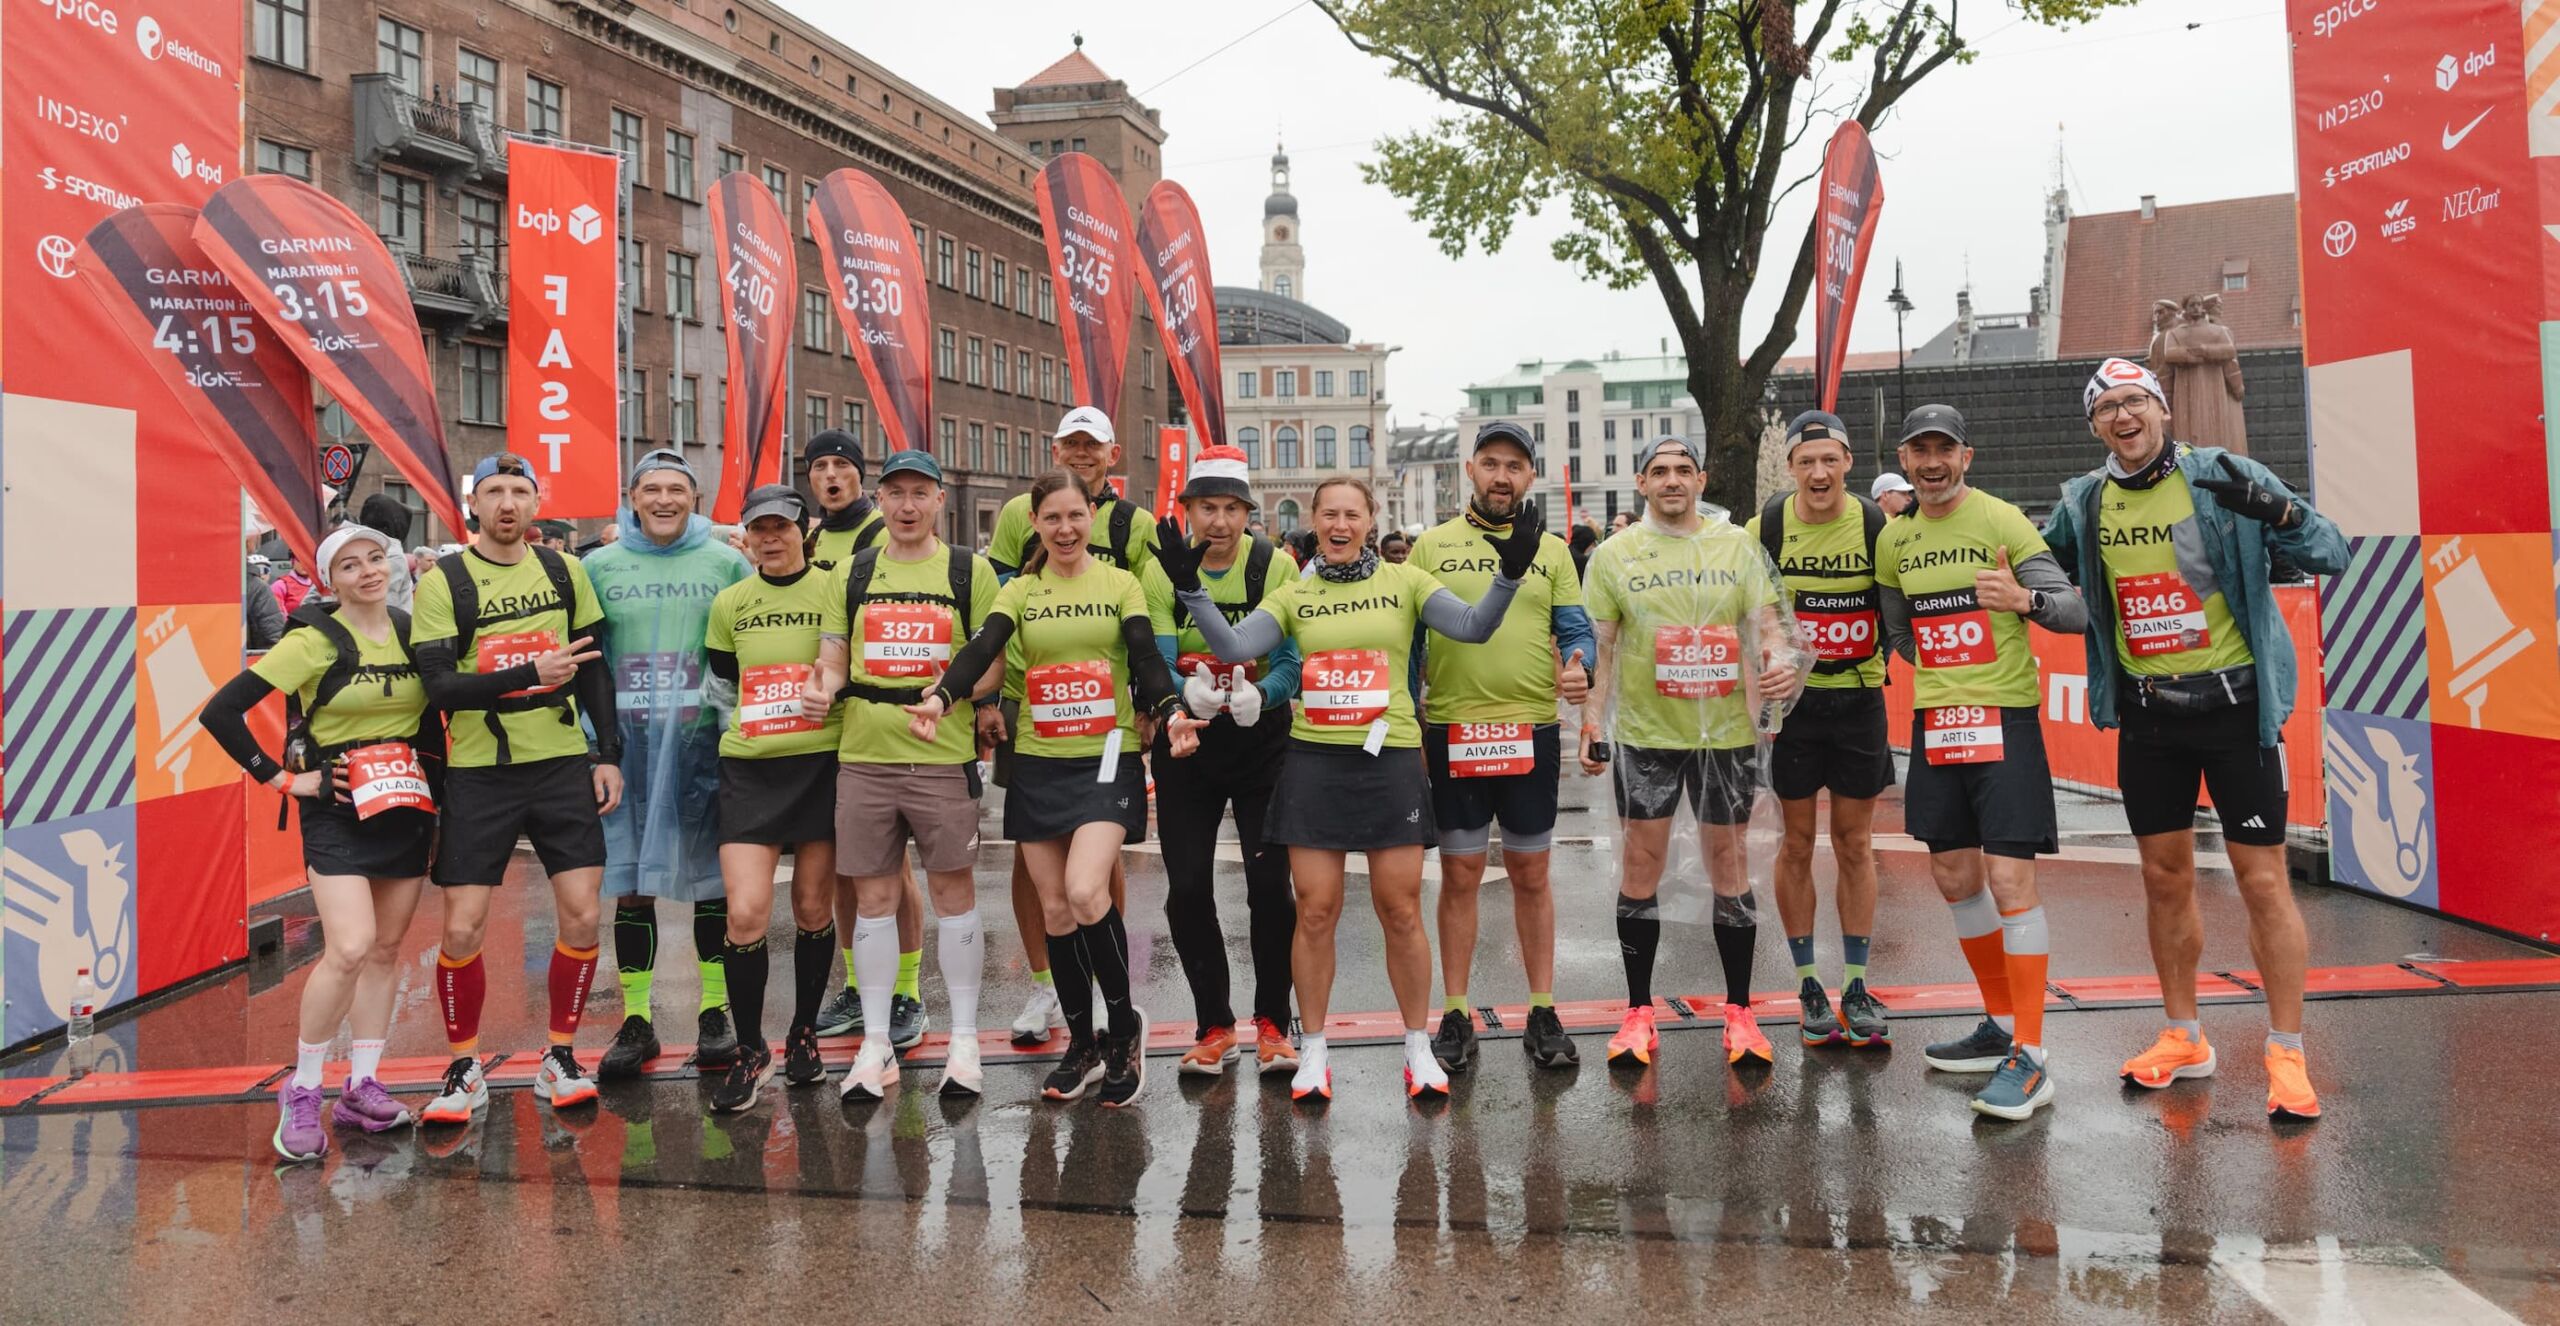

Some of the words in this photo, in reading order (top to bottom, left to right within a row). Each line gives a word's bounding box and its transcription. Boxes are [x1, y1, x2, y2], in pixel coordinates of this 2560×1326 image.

[40, 0, 118, 34] pice
[167, 40, 222, 77] elektrum
[2464, 43, 2495, 76] dpd
[38, 96, 120, 143] INDEXO
[2319, 90, 2383, 131] INDEXO
[196, 159, 222, 184] dpd
[2340, 142, 2411, 181] SPORTLAND
[1828, 182, 1860, 208] GARMIN
[1067, 206, 1118, 241] GARMIN
[2381, 216, 2416, 238] WESS
[260, 237, 352, 254] GARMIN
[737, 222, 782, 267] GARMIN
[844, 229, 900, 254] GARMIN
[1064, 228, 1107, 258] MARATHON
[1158, 229, 1191, 268] GARMIN
[1827, 227, 1854, 275] 3:00
[267, 265, 342, 279] MARATHON
[347, 264, 359, 276] in
[733, 242, 771, 280] MARATHON
[843, 255, 892, 275] MARATHON
[1059, 244, 1112, 296] 3:45
[145, 268, 231, 287] GARMI
[726, 260, 774, 316] 4:00
[1162, 261, 1189, 293] MARATHON
[150, 297, 236, 312] MARATHON
[240, 299, 253, 312] in
[274, 280, 369, 322] 3:15
[842, 273, 902, 317] 3:30
[1165, 274, 1197, 331] 4:30
[153, 315, 256, 354] 4:15
[2099, 524, 2174, 547] GARM
[1440, 558, 1547, 578] GARN
[1780, 553, 1872, 570] ARMIN
[1898, 547, 1988, 574] GARMIN
[606, 583, 719, 601] GARMIN
[1628, 569, 1738, 593] GARMIN
[478, 590, 561, 616] ARMI
[1023, 603, 1120, 621] GARMIN
[1297, 594, 1400, 619] GARMIN
[1805, 596, 1865, 609] GARMIN
[1914, 594, 1971, 611] GARMIN
[2124, 592, 2187, 617] 3846
[880, 621, 935, 641] 3871
[1801, 619, 1869, 643] 3:00
[1918, 620, 1984, 650] 3:30
[2133, 619, 2183, 635] DAINIS
[493, 650, 553, 672] 385
[883, 646, 931, 657] ELVIJS
[1669, 644, 1727, 663] 3849
[629, 670, 688, 689] 3950
[1315, 669, 1375, 688] 3847
[1667, 667, 1728, 680] MARTINS
[632, 693, 685, 705] ANDRS
[1040, 680, 1100, 701] 3850
[1329, 695, 1359, 705] ILZE
[764, 705, 793, 715] LITA
[1052, 705, 1092, 717] GUNA
[1934, 706, 1985, 727] 3899
[1460, 723, 1519, 740] 3858
[1941, 731, 1977, 744] ARTIS
[1465, 745, 1517, 757] AIVARS
[361, 759, 419, 779] 1504
[373, 780, 422, 793] VLADA
